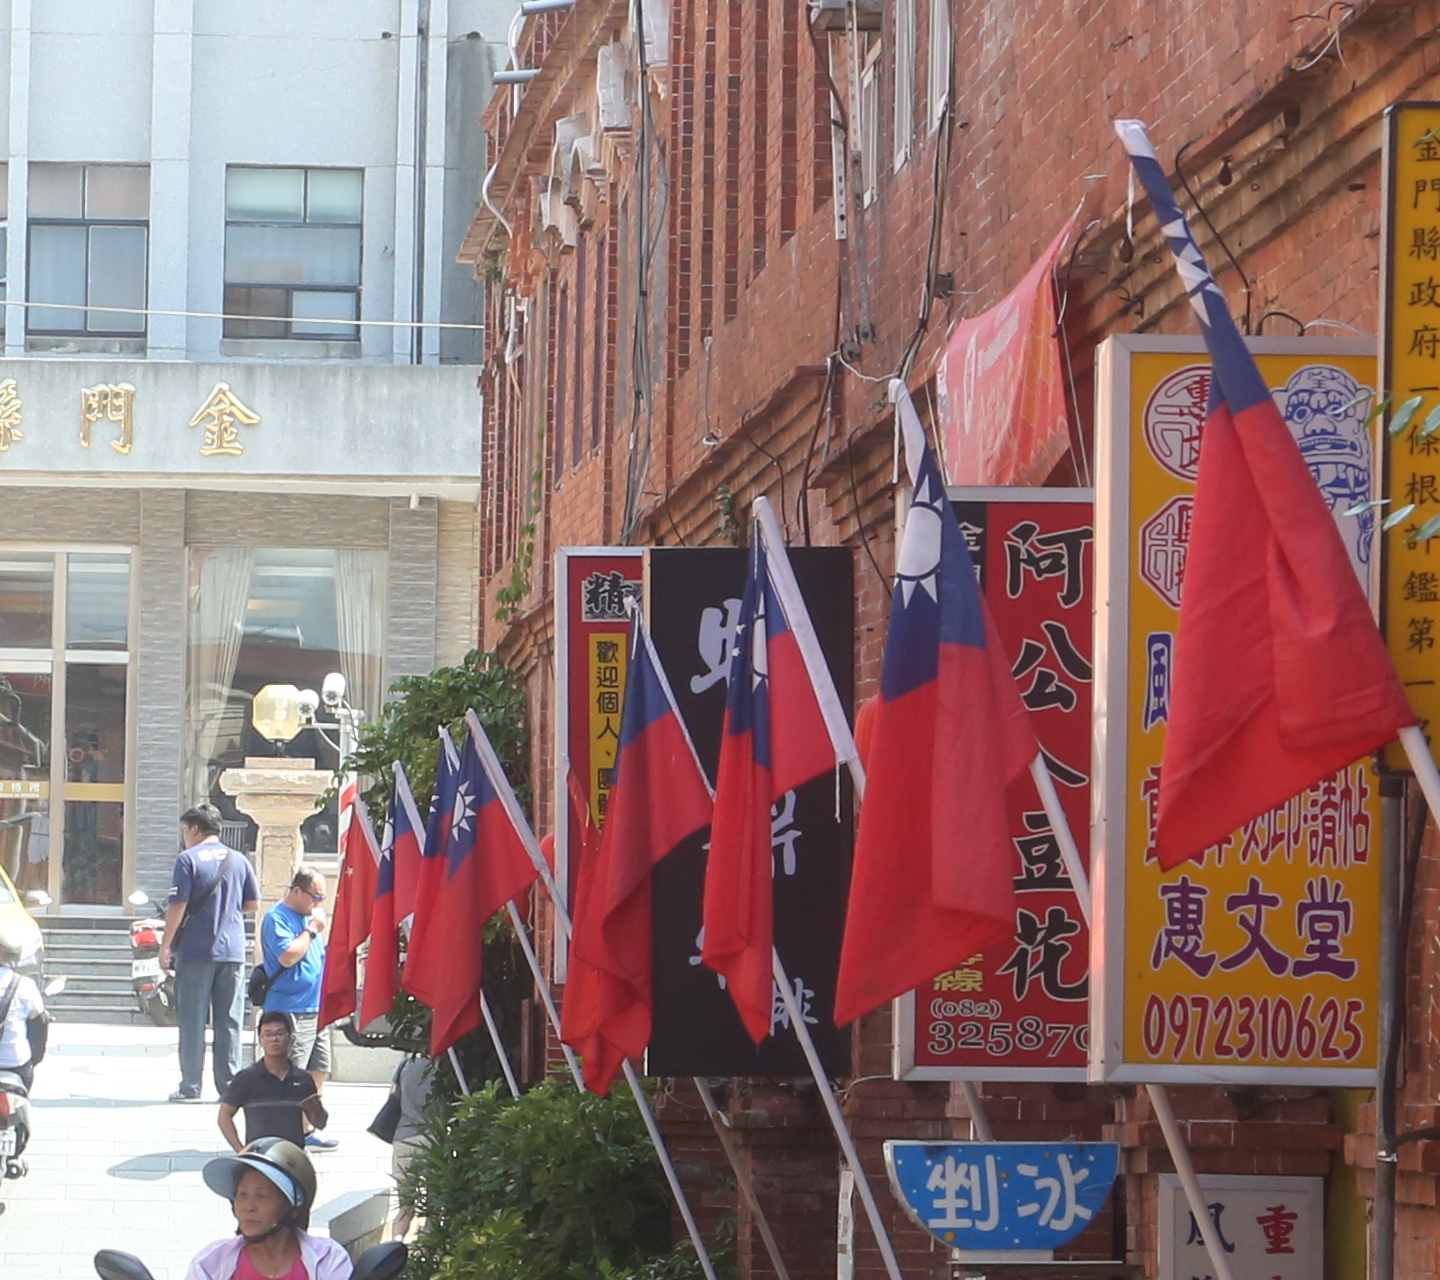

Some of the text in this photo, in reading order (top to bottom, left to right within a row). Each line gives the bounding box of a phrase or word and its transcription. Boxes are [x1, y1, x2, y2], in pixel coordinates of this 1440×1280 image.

[1151, 875, 1357, 980] 惠文堂
[1142, 993, 1364, 1062] 0972310625
